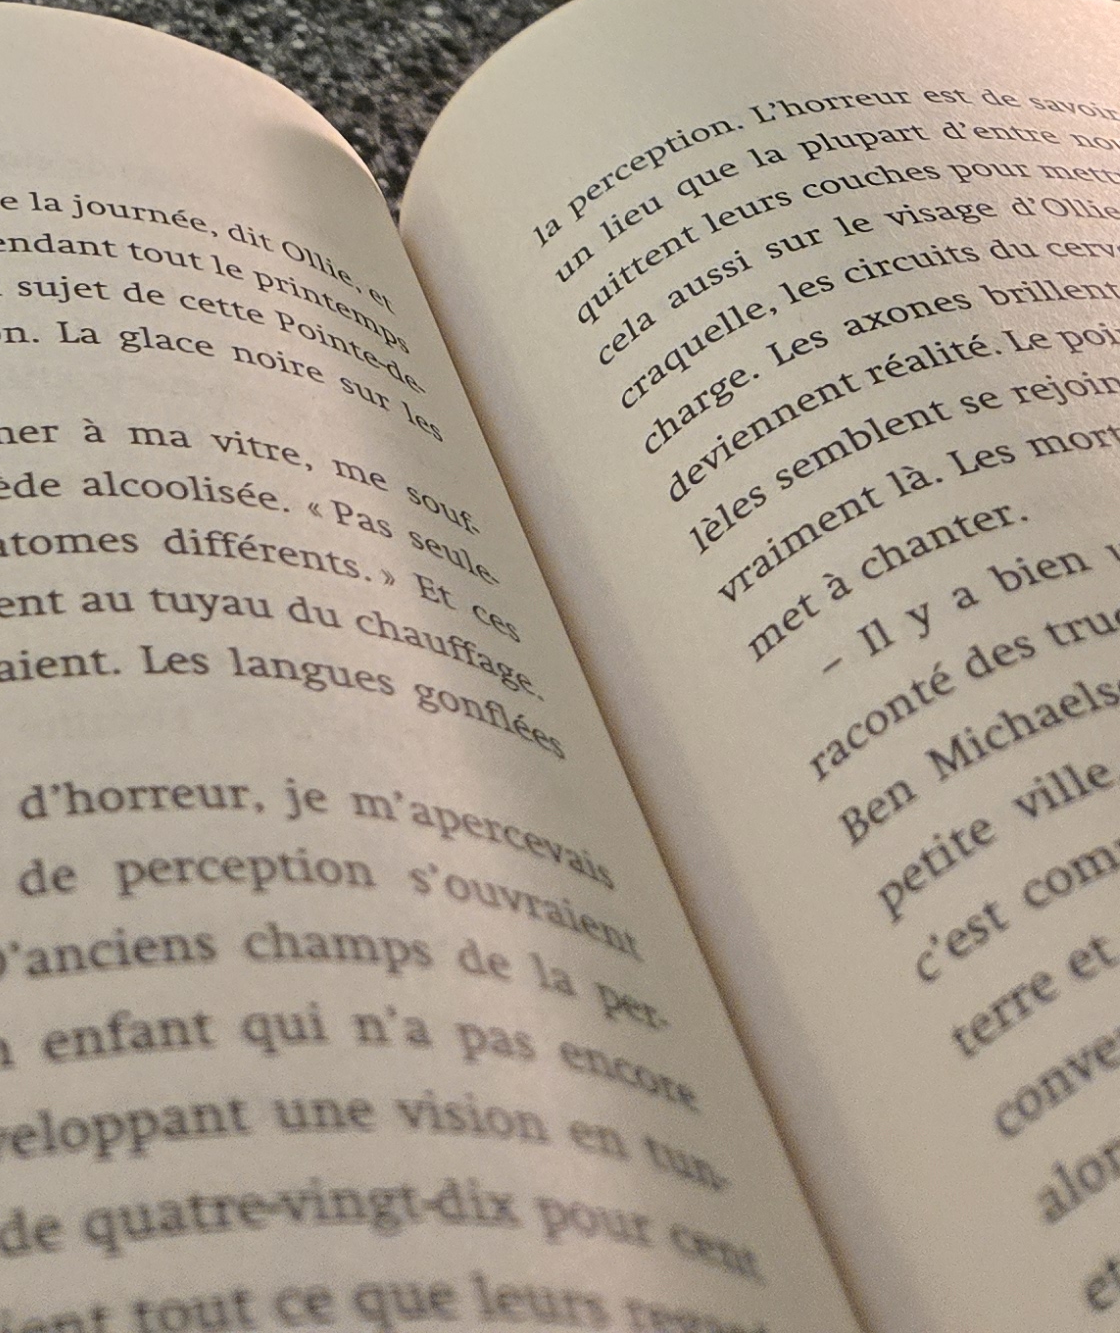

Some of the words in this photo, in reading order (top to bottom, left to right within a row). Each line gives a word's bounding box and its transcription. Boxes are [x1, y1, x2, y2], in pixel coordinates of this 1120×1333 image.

[535, 220, 561, 246] la
[569, 121, 743, 221] perception.
[924, 90, 971, 103] est
[982, 90, 1020, 107] de
[1030, 99, 1116, 119] savoir
[557, 247, 594, 282] un
[601, 197, 663, 242] lieu
[678, 164, 738, 198] que
[748, 149, 787, 167] la
[798, 126, 929, 161] plupart
[18, 276, 108, 303] sujet
[123, 282, 164, 305] de
[31, 192, 61, 211] la
[73, 195, 217, 237] journée,
[282, 241, 362, 293] Ollie,
[129, 244, 202, 270] tout
[213, 255, 242, 279] le
[579, 227, 699, 323] quittent
[702, 192, 792, 233] leurs
[802, 165, 941, 198] couches
[948, 163, 1031, 183] pour
[600, 313, 655, 365] cela
[668, 250, 752, 309] aussi
[766, 229, 821, 259] sur
[834, 217, 873, 236] le
[884, 203, 997, 226] visage
[58, 322, 100, 344] La
[120, 327, 212, 356] glace
[233, 347, 322, 382] noire
[341, 378, 388, 410] sur
[622, 303, 777, 408] craquelle,
[780, 276, 834, 304] les
[845, 245, 979, 283] circuits
[990, 239, 1039, 260] du
[646, 370, 759, 454] charge.
[767, 331, 828, 366] Les
[844, 295, 972, 336] axones
[980, 280, 1119, 306] brillent
[85, 419, 104, 442] à
[129, 428, 190, 447] ma
[212, 432, 312, 470] vitre,
[334, 461, 385, 490] me
[671, 374, 860, 502] deviennent
[866, 334, 1000, 385] réalité.
[1003, 331, 1052, 353] Le
[83, 471, 288, 512] alcoolisée.
[333, 501, 392, 537] Pas
[691, 486, 766, 554] lèles
[776, 402, 951, 489] semblent
[960, 392, 1001, 414] se
[719, 488, 883, 601] vraiment
[887, 466, 942, 497] là.
[948, 446, 1015, 476] Les
[164, 529, 370, 580] différents.
[749, 596, 819, 661] met
[824, 574, 851, 600] à
[862, 506, 1027, 579] chanter.
[858, 619, 894, 656] Il
[953, 588, 979, 609] a
[988, 553, 1091, 592] bien
[82, 593, 133, 612] au
[150, 589, 272, 621] tuyau
[288, 597, 340, 628] du
[141, 646, 209, 674] Les
[230, 648, 394, 695] langues
[415, 685, 564, 759] gonflées
[811, 663, 954, 781] raconté
[966, 637, 1035, 679] des
[287, 779, 325, 820] je
[840, 781, 916, 846] Ben
[879, 820, 994, 923] petite
[1014, 765, 1113, 818] ville
[19, 859, 75, 896] de
[116, 849, 374, 897] perception
[42, 1011, 213, 1063] enfant
[953, 973, 1055, 1057] terre
